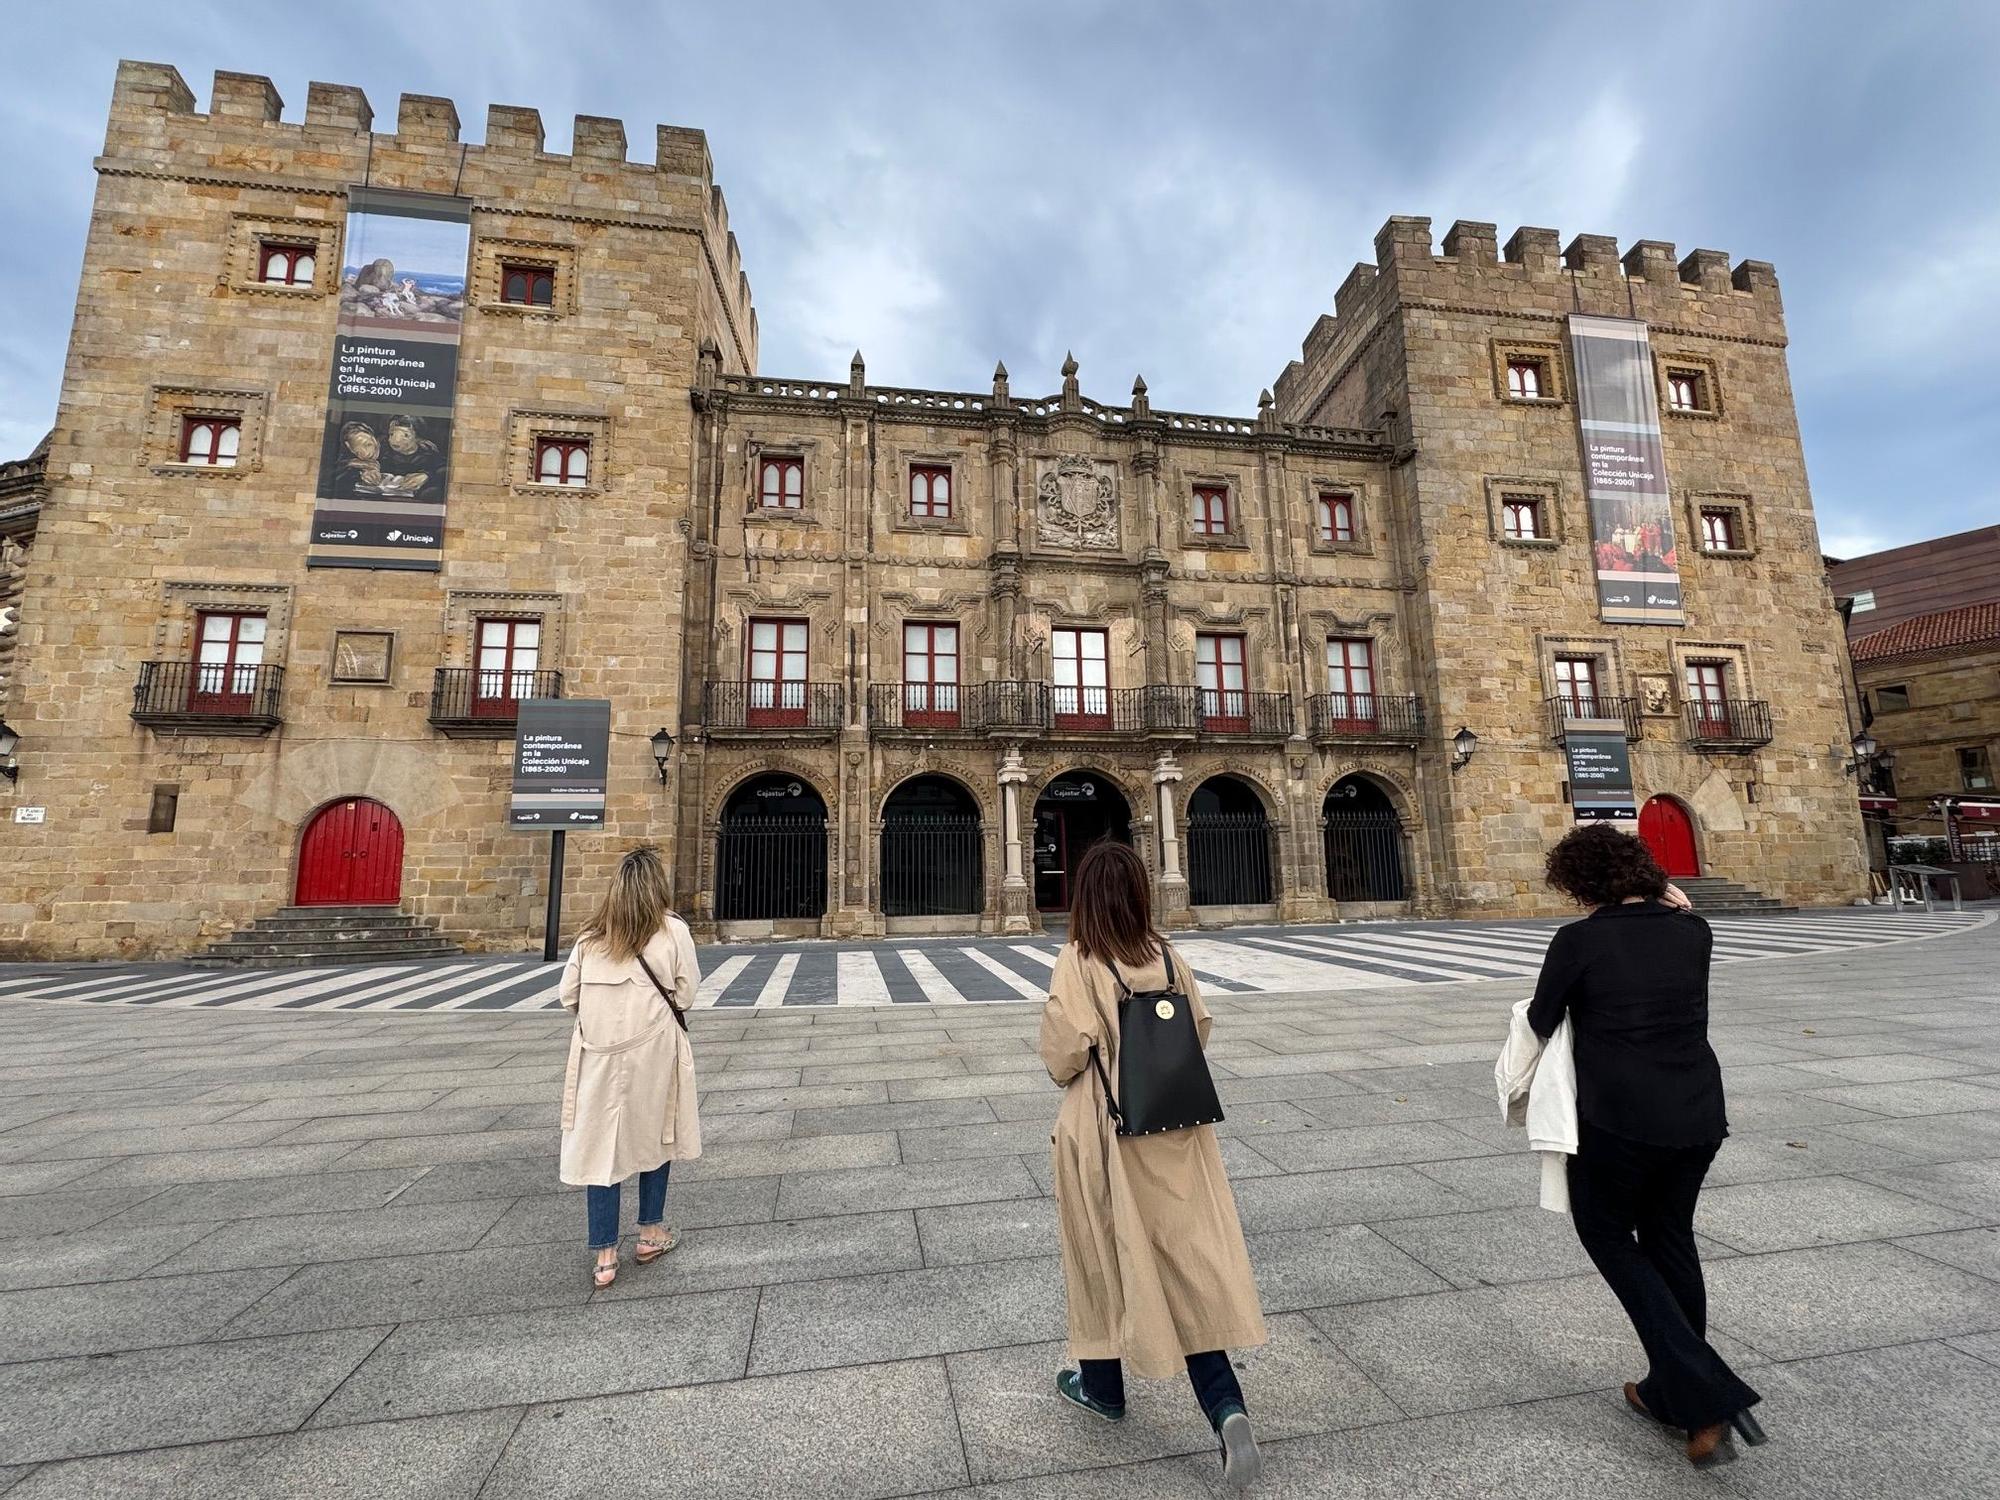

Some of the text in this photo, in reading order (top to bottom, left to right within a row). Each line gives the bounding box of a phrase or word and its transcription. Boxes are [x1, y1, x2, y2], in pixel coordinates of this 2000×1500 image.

[342, 344, 396, 356] La pintura
[340, 356, 425, 368] contemporánea
[340, 364, 365, 373] en la
[338, 374, 436, 390] Colección Unicaja
[337, 384, 402, 397] (1865-2000)
[1600, 445, 1625, 453] pintura
[1591, 453, 1645, 463] contemporánea
[1592, 469, 1654, 481] Colección Unicaja
[402, 534, 434, 544] Unicaja
[535, 734, 562, 742] pintura
[523, 742, 582, 750] contemporánea
[561, 758, 590, 766] Unicaja
[757, 790, 786, 798] Cajastur
[1054, 790, 1081, 798] Cajastur
